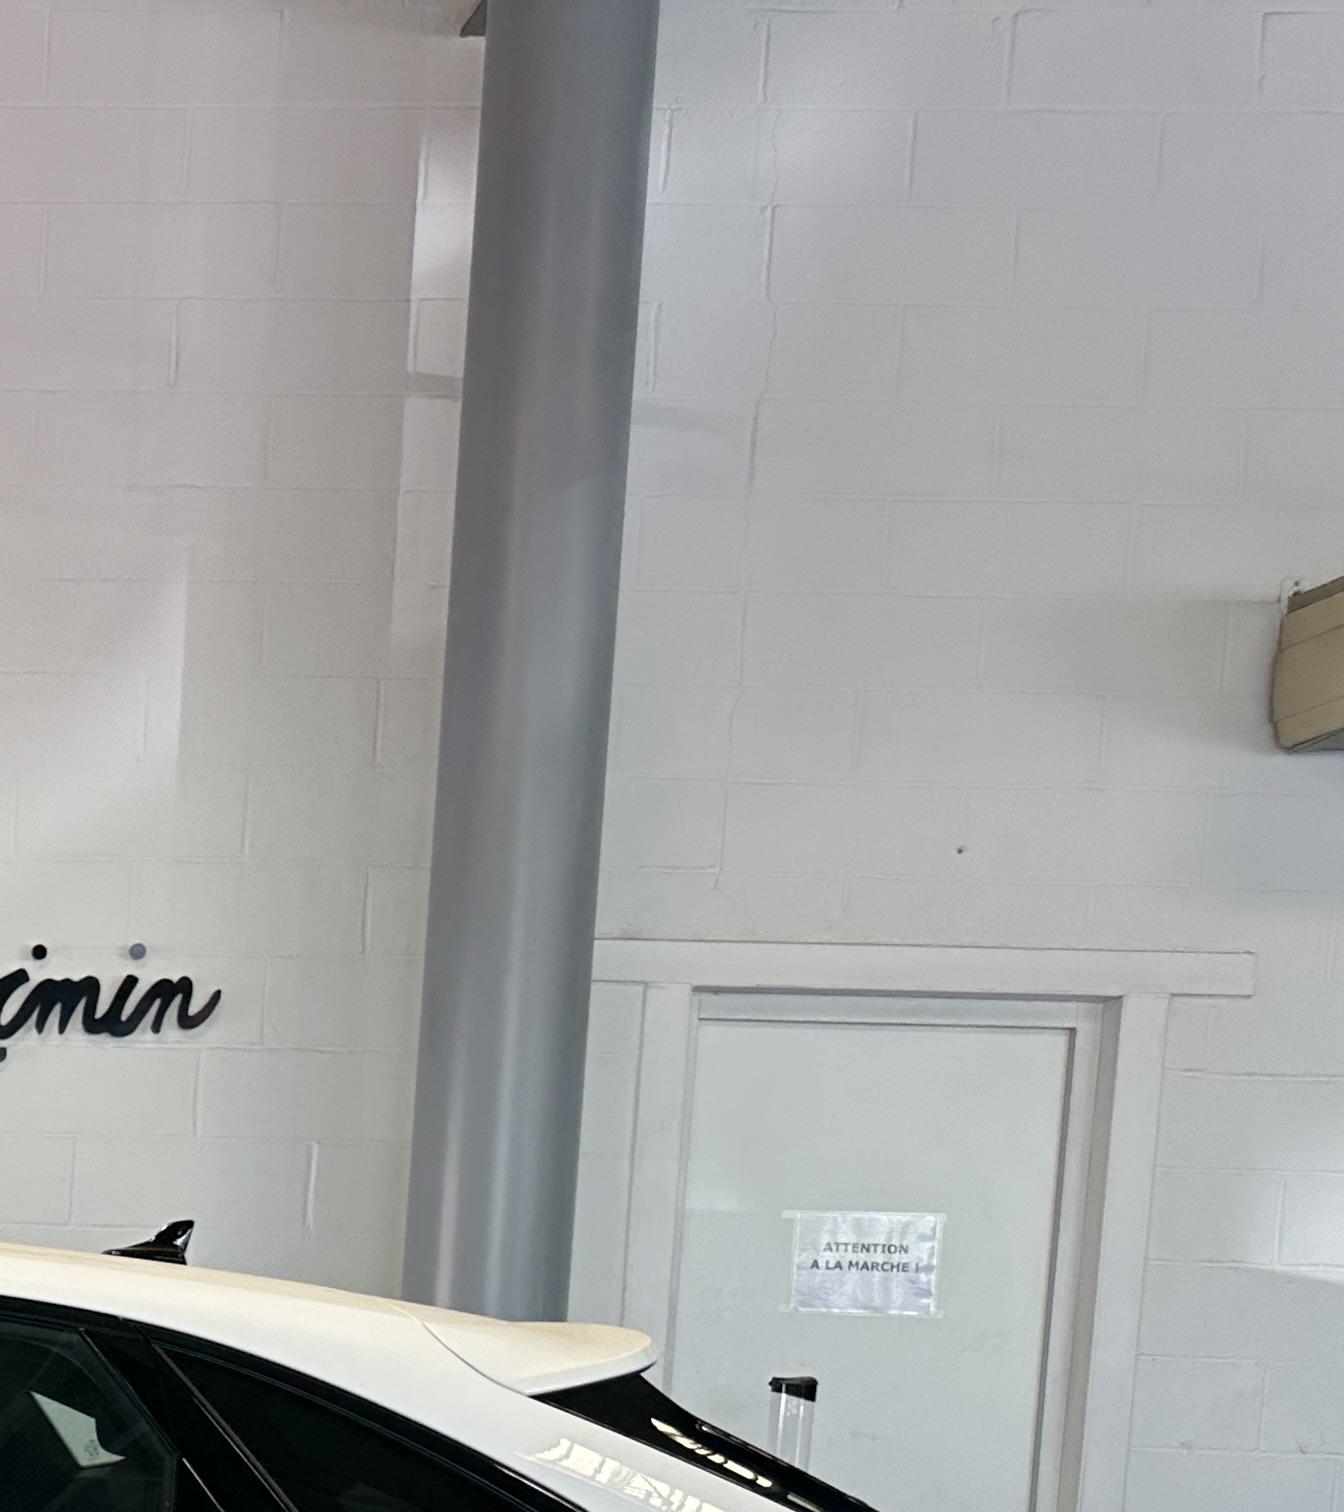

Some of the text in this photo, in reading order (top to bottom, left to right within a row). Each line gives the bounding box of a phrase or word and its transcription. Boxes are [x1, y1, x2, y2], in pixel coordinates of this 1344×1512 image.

[823, 1241, 909, 1254] ATTENTION
[810, 1259, 820, 1270] A
[825, 1260, 843, 1271] LA
[848, 1260, 910, 1272] MARCHE
